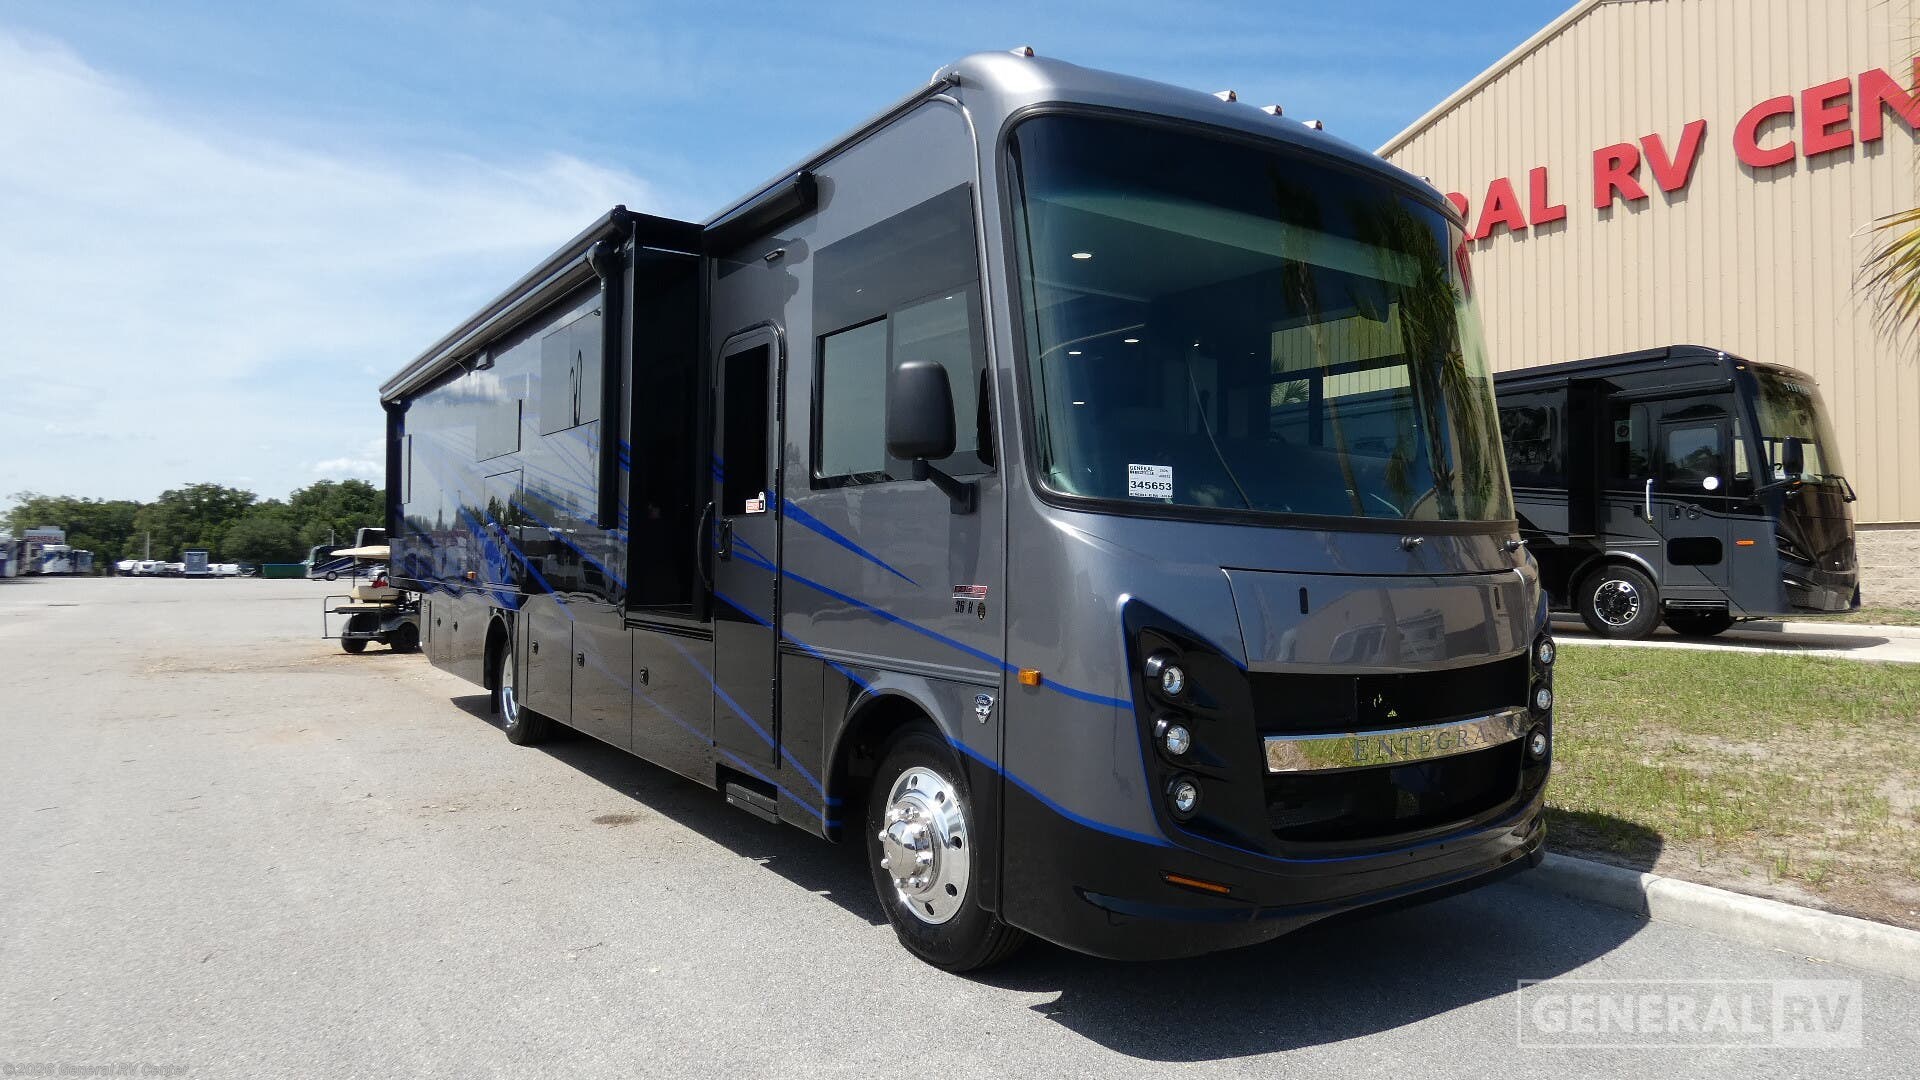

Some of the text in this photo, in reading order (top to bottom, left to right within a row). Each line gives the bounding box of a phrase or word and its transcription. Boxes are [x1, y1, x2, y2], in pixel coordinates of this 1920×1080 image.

[1593, 119, 1707, 209] RV
[1130, 480, 1172, 491] 345653
[1353, 728, 1489, 762] ENTEGRA
